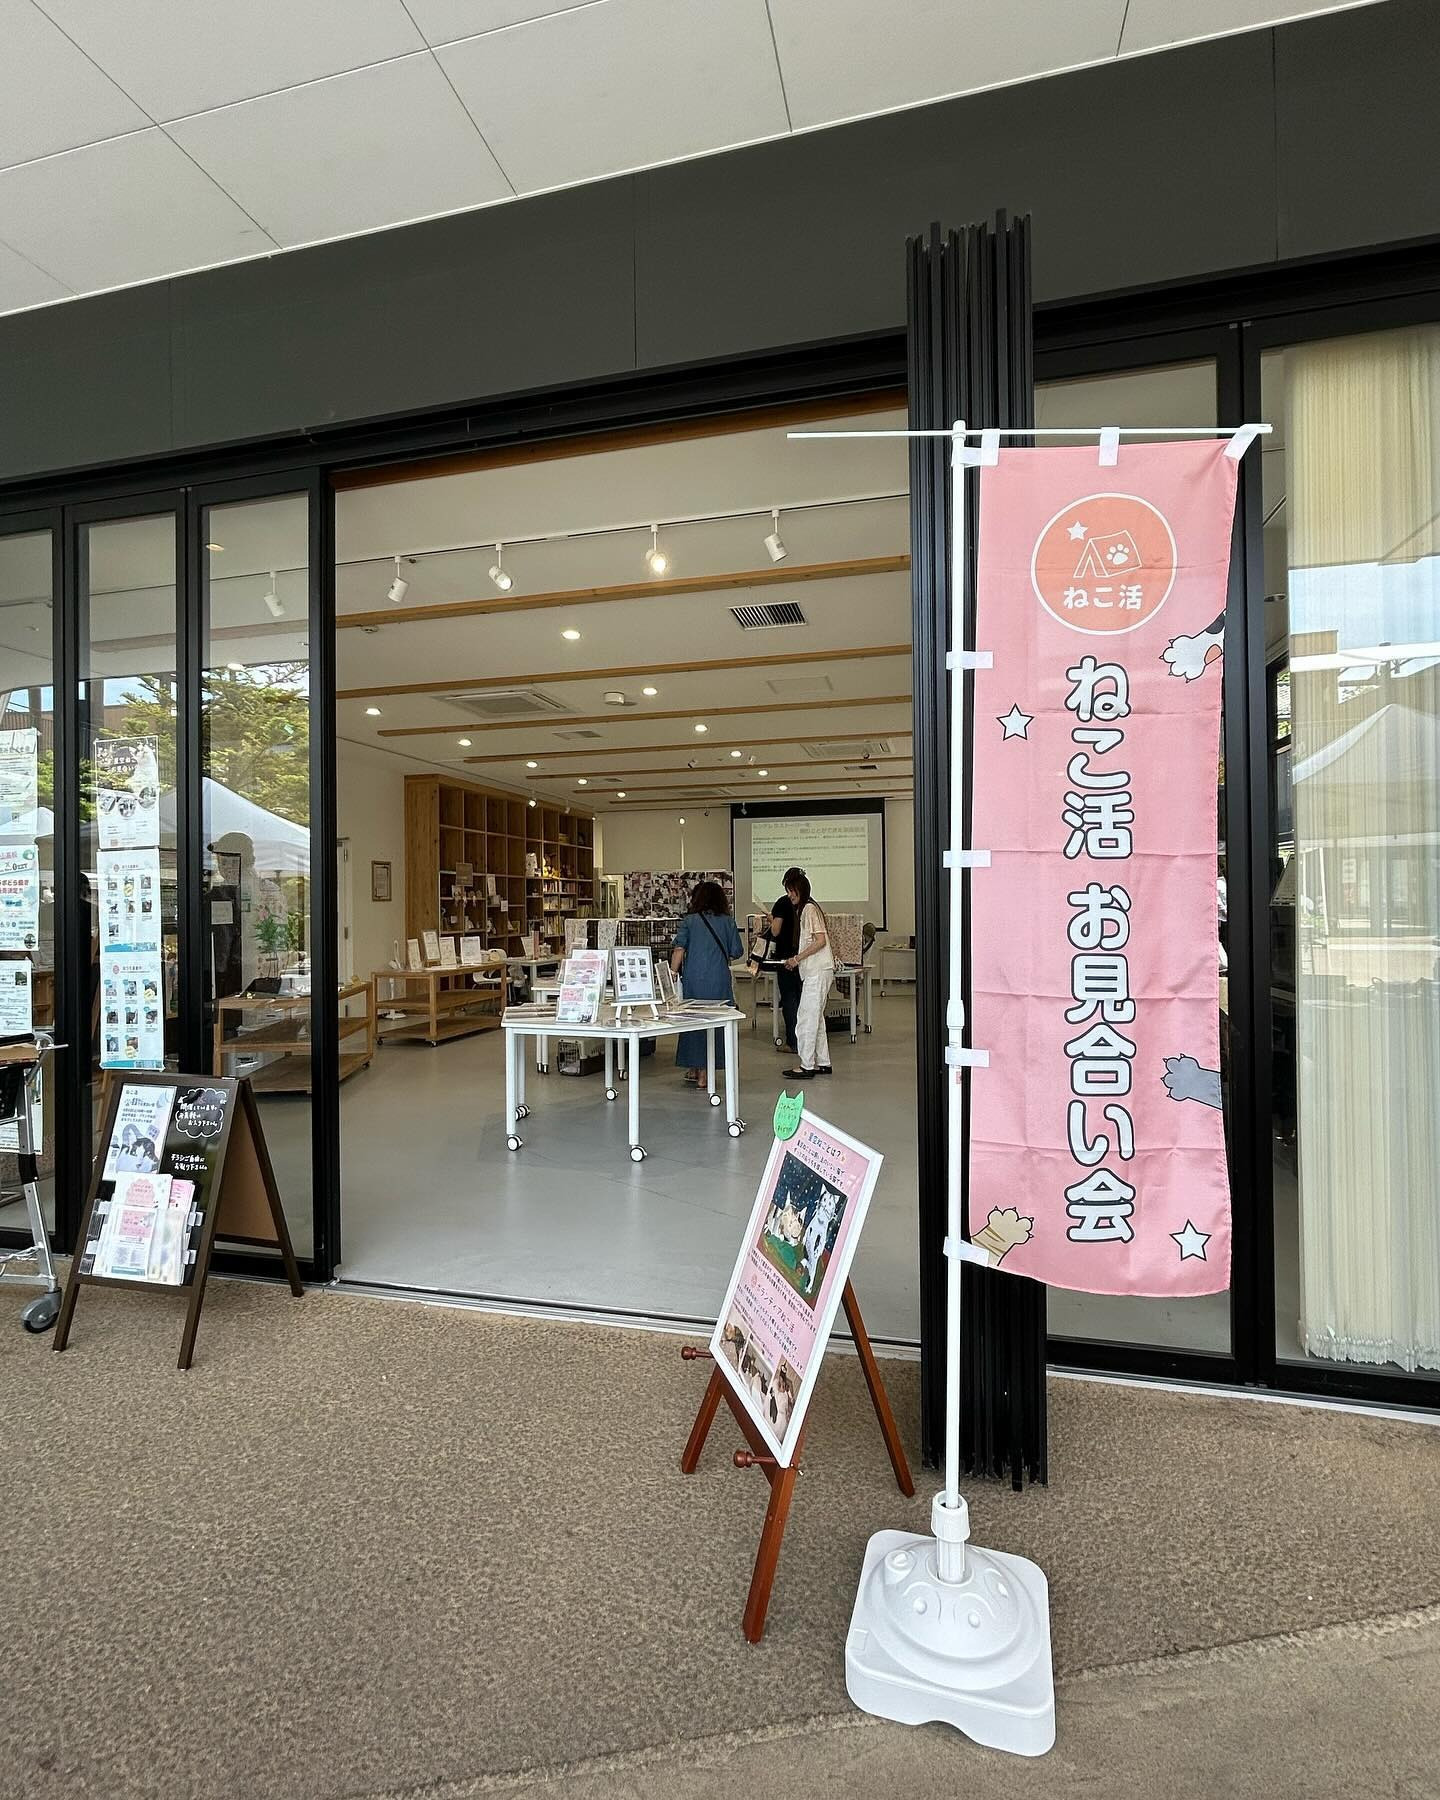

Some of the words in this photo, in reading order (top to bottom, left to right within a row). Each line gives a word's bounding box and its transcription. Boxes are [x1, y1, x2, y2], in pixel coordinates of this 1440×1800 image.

[1063, 584, 1143, 611] ねこ活
[1062, 655, 1135, 860] ねこ活
[1063, 881, 1137, 1244] お見合い会
